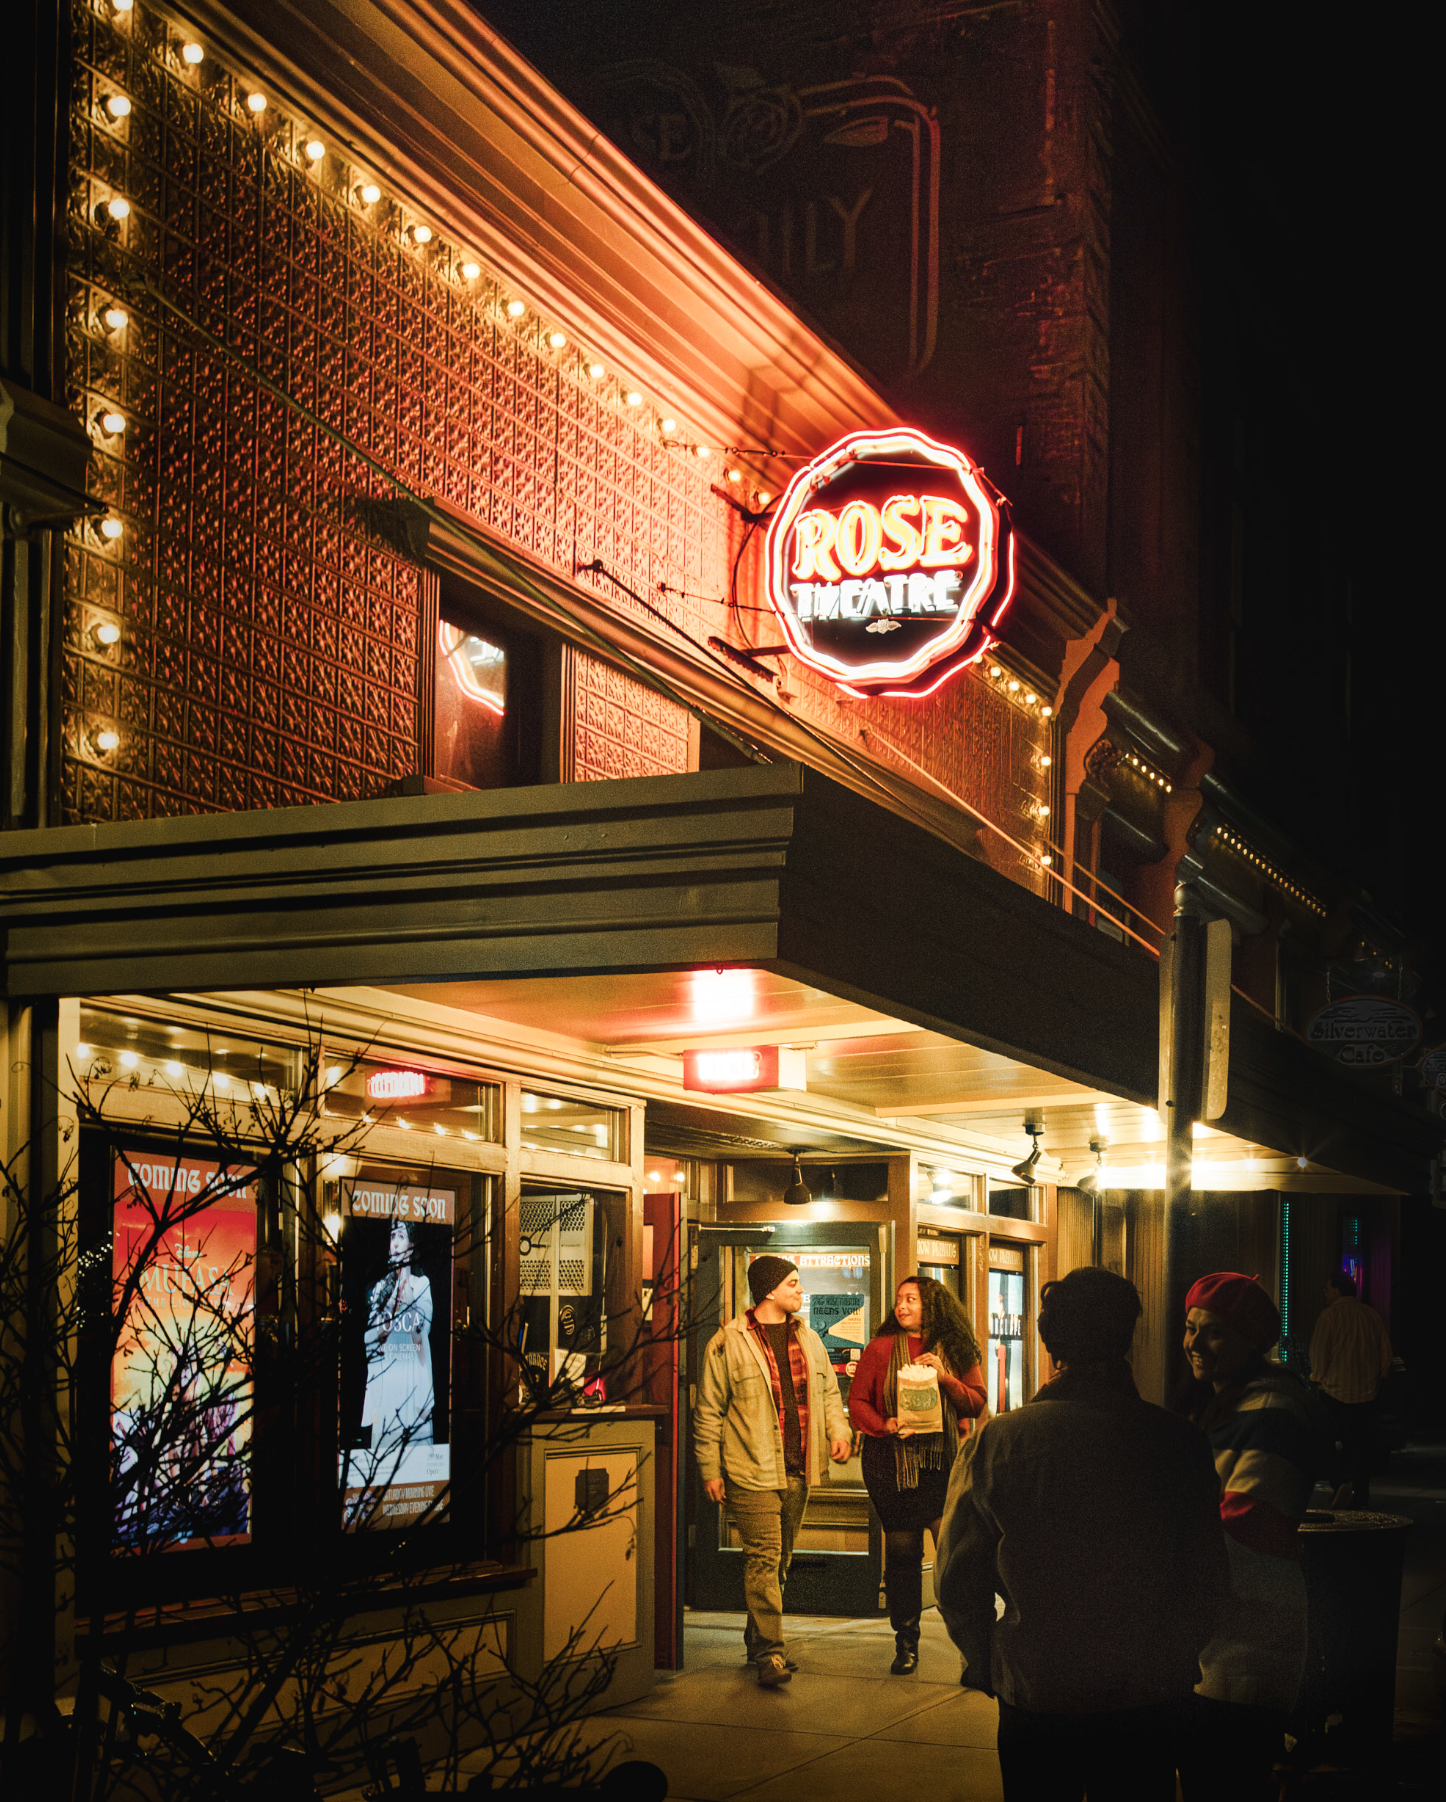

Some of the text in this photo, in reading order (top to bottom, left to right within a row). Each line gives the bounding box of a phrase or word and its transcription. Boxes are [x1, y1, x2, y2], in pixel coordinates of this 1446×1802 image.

[791, 495, 973, 581] ROSE
[790, 570, 962, 622] THEATRE
[1310, 1021, 1416, 1040] Silverwater
[128, 1163, 201, 1194] COMING
[352, 1190, 446, 1219] COMING SOON
[800, 1255, 870, 1266] ATTRACTIONS
[140, 1263, 235, 1297] MUFASA
[145, 1296, 166, 1308] THE
[813, 1307, 839, 1315] NEEDS
[388, 1343, 398, 1352] ON
[399, 1343, 421, 1352] SCREEN
